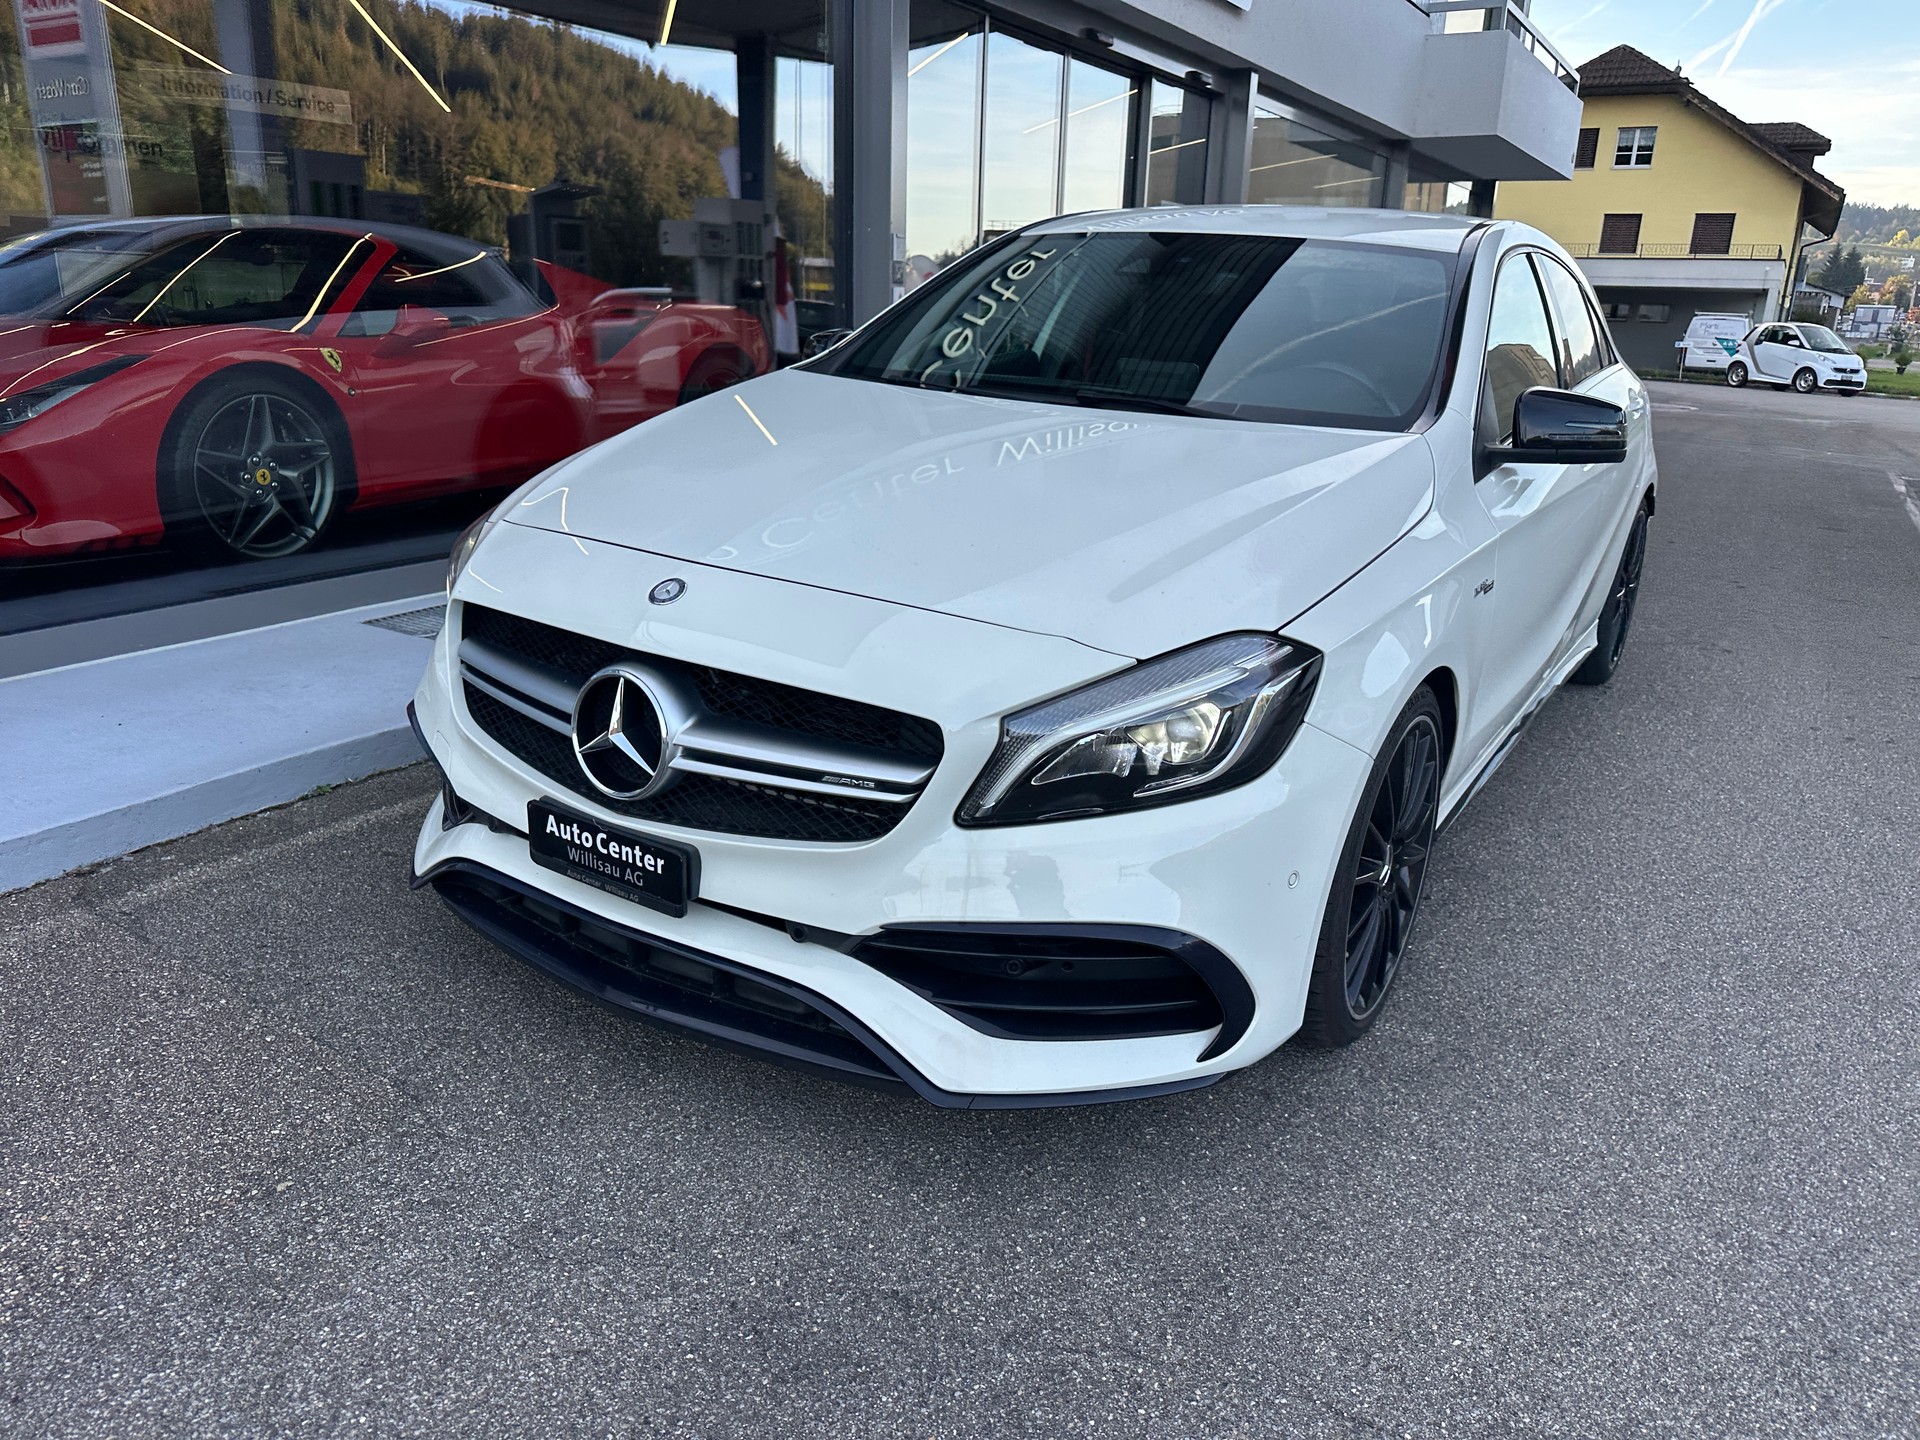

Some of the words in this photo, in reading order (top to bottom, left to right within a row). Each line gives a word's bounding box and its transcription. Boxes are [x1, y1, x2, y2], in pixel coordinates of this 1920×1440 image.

[275, 88, 336, 115] Service
[838, 777, 876, 790] AMG
[566, 845, 621, 878] Willisau
[624, 867, 644, 887] AG
[566, 868, 581, 881] Auto
[581, 873, 602, 890] Center
[604, 883, 629, 900] Willisau
[628, 892, 640, 902] AG
